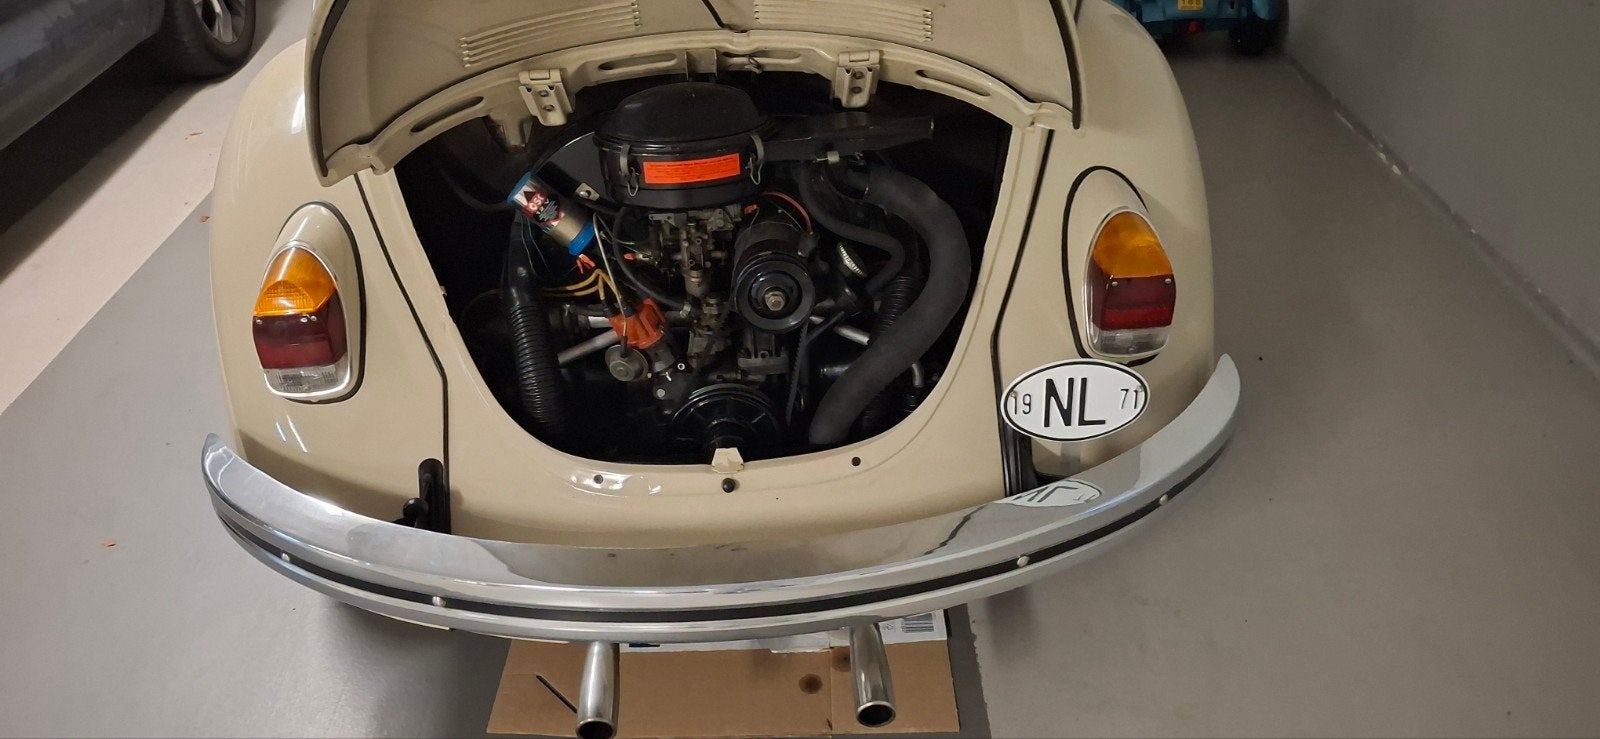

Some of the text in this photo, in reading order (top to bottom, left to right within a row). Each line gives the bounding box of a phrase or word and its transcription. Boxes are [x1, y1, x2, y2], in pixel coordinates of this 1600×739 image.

[1012, 377, 1139, 428] 19 NL 71
